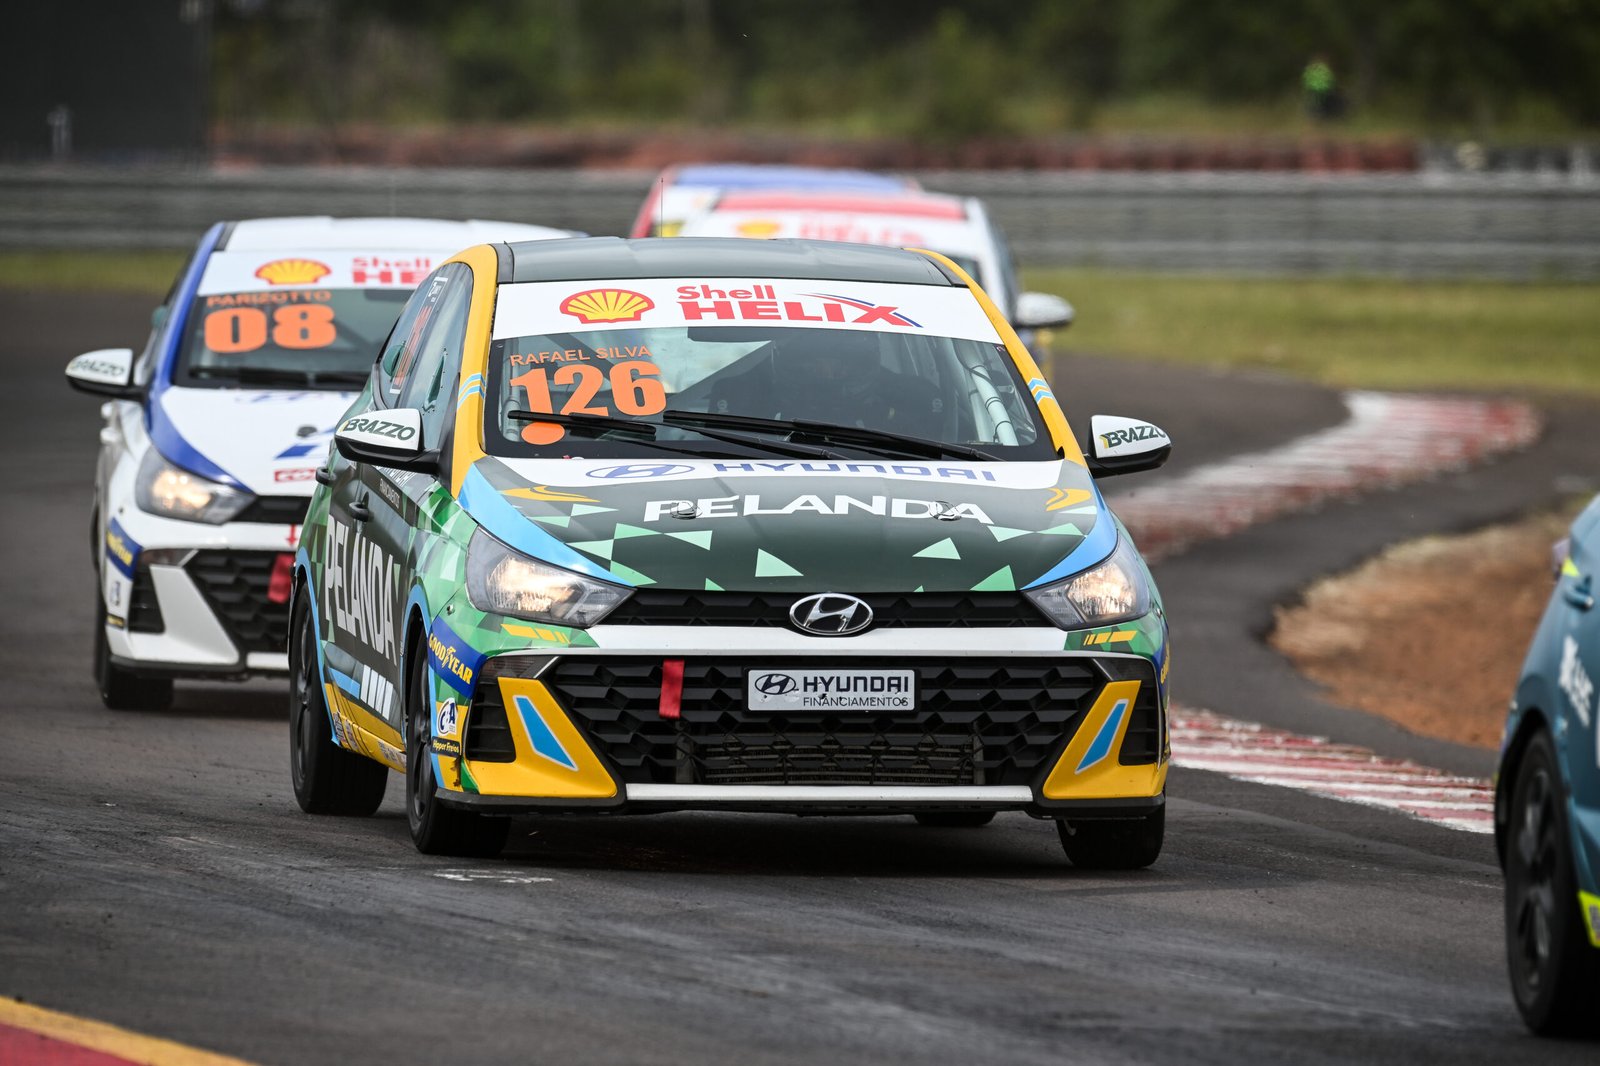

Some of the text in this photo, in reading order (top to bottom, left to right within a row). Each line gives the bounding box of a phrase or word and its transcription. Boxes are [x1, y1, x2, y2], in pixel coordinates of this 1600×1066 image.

[353, 257, 430, 269] Shell
[676, 285, 776, 299] Shell
[677, 300, 914, 327] HELIX
[204, 304, 337, 353] 08
[510, 345, 653, 366] RAFAEL SILVA
[509, 360, 667, 417] 126
[342, 418, 416, 441] BRAZZO
[713, 463, 997, 481] HYUNDAI
[643, 495, 995, 525] PELANDA
[325, 514, 398, 667] PELANDA
[803, 676, 909, 692] HYUNDAI
[803, 696, 909, 707] FINANCIAMENTOS
